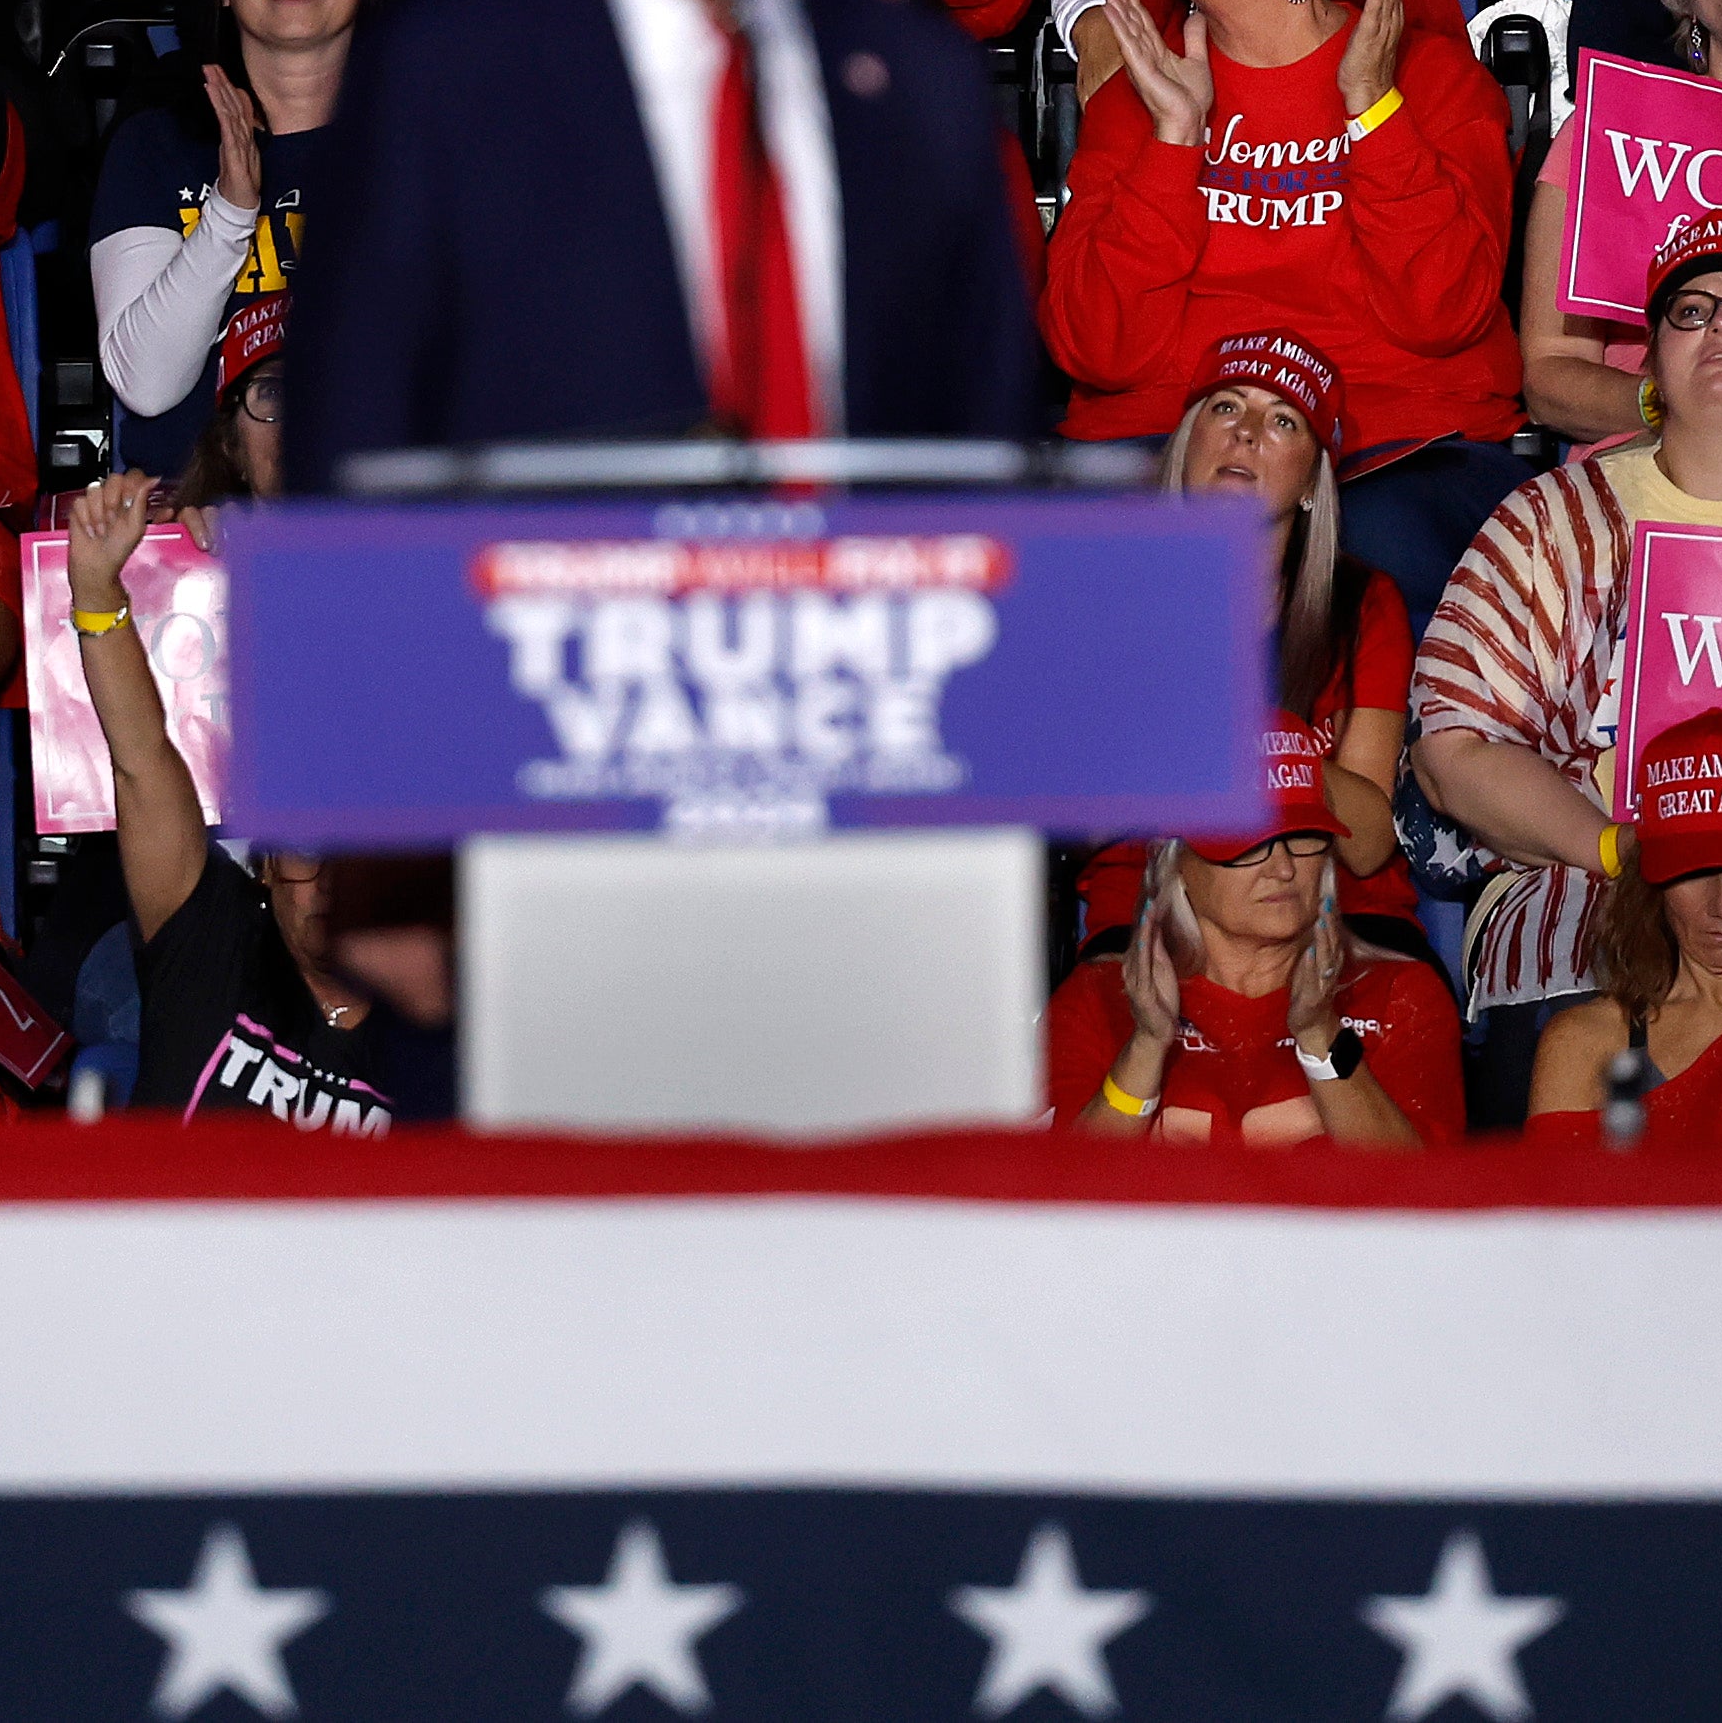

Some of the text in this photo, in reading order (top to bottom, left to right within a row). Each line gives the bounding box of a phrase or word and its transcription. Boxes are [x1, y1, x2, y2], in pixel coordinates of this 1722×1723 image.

[1199, 186, 1344, 229] TRUMP
[492, 586, 992, 699] TRUMP
[548, 681, 937, 760] VANCE
[1645, 757, 1694, 788] MAKE
[1656, 789, 1713, 819] GREAT
[220, 1036, 393, 1146] TRUM
